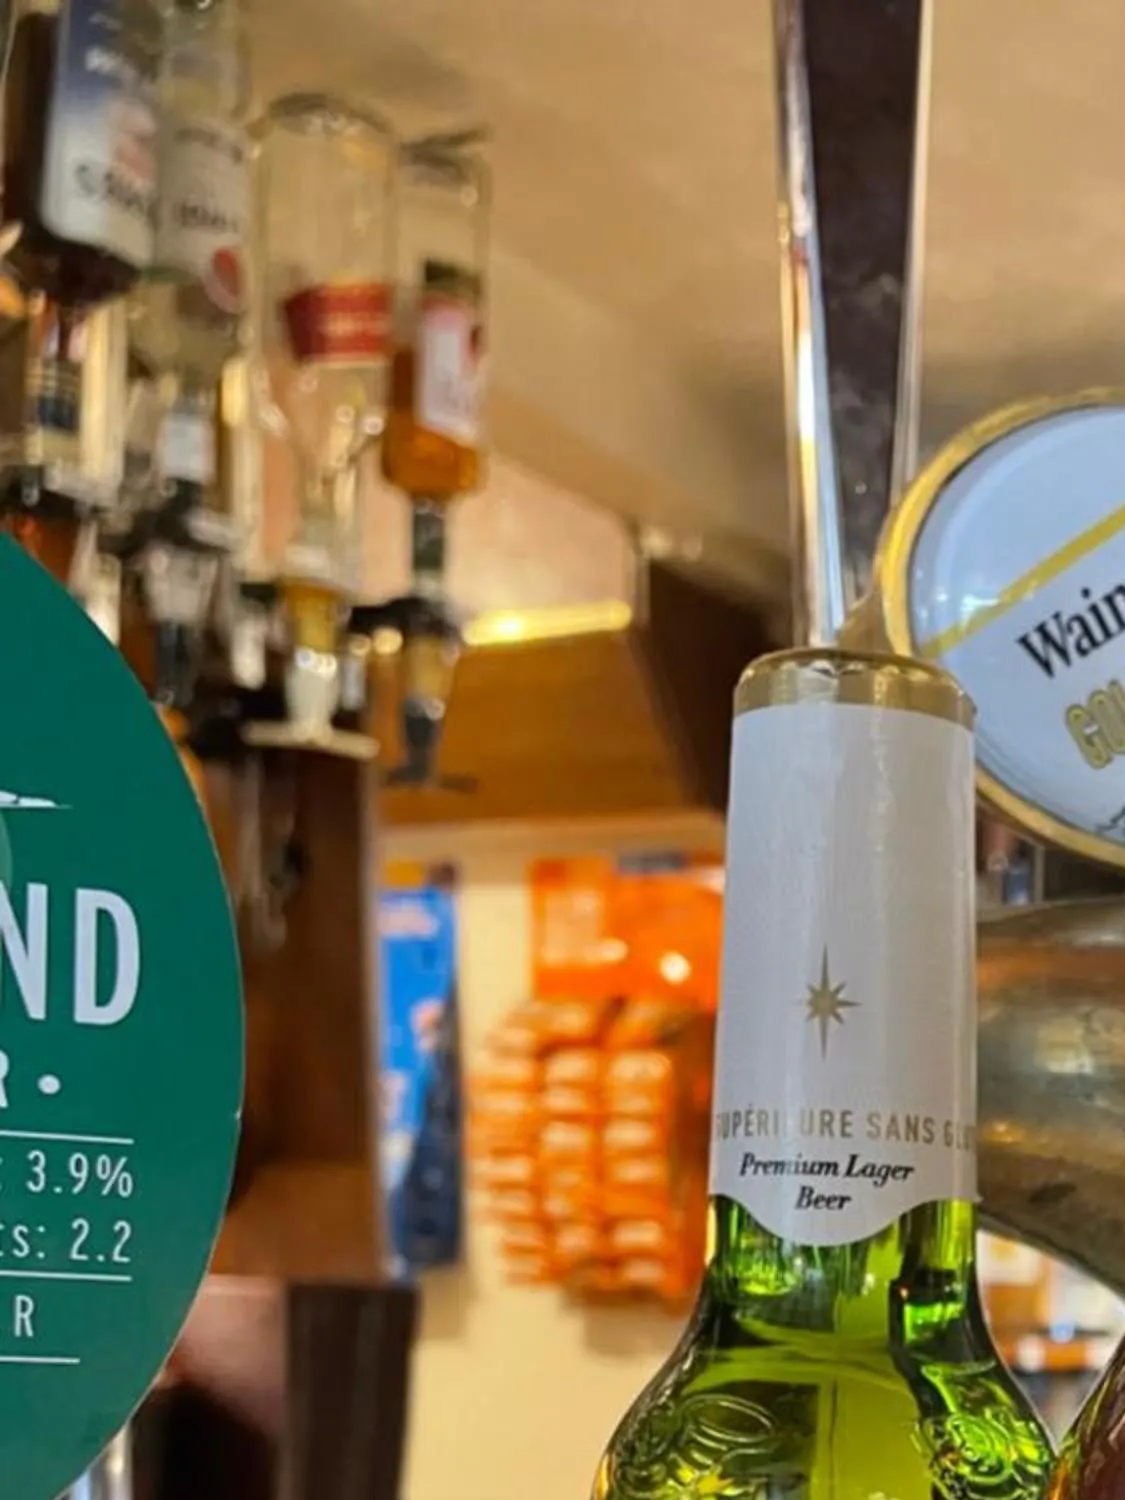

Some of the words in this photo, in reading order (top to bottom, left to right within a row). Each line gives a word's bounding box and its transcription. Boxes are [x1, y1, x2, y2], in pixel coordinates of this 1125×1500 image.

[866, 1111, 936, 1145] SANS
[26, 1150, 133, 1198] 3.9%
[739, 1152, 839, 1178] Premium
[843, 1154, 915, 1188] Lager
[795, 1186, 853, 1211] Beer
[70, 1218, 132, 1263] 2.2
